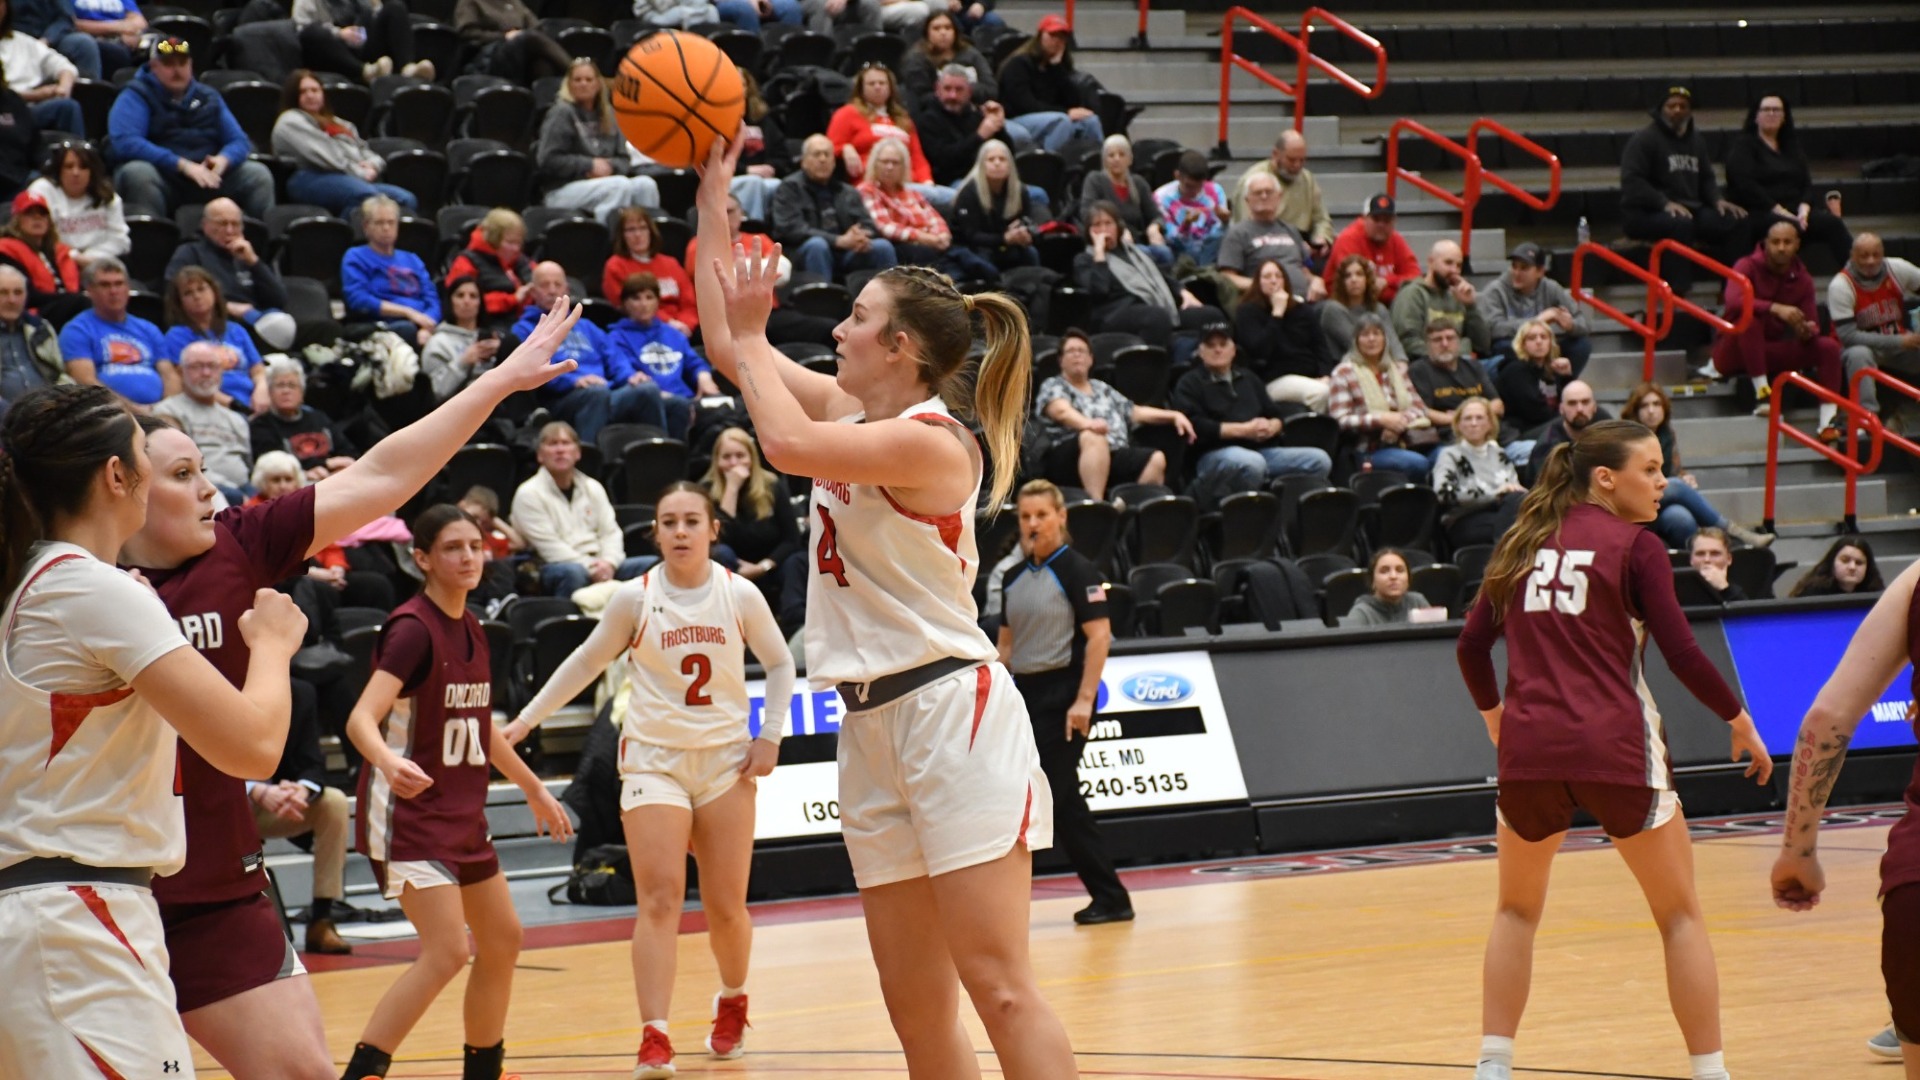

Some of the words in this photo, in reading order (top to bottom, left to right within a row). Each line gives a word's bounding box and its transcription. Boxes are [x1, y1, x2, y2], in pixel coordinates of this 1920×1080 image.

[816, 503, 851, 588] 4
[1523, 548, 1597, 616] 25
[661, 625, 727, 650] FROSTBURG
[680, 653, 713, 707] 2
[1133, 675, 1184, 701] Ford
[1119, 748, 1145, 767] MD
[1080, 773, 1188, 798] 240-5135
